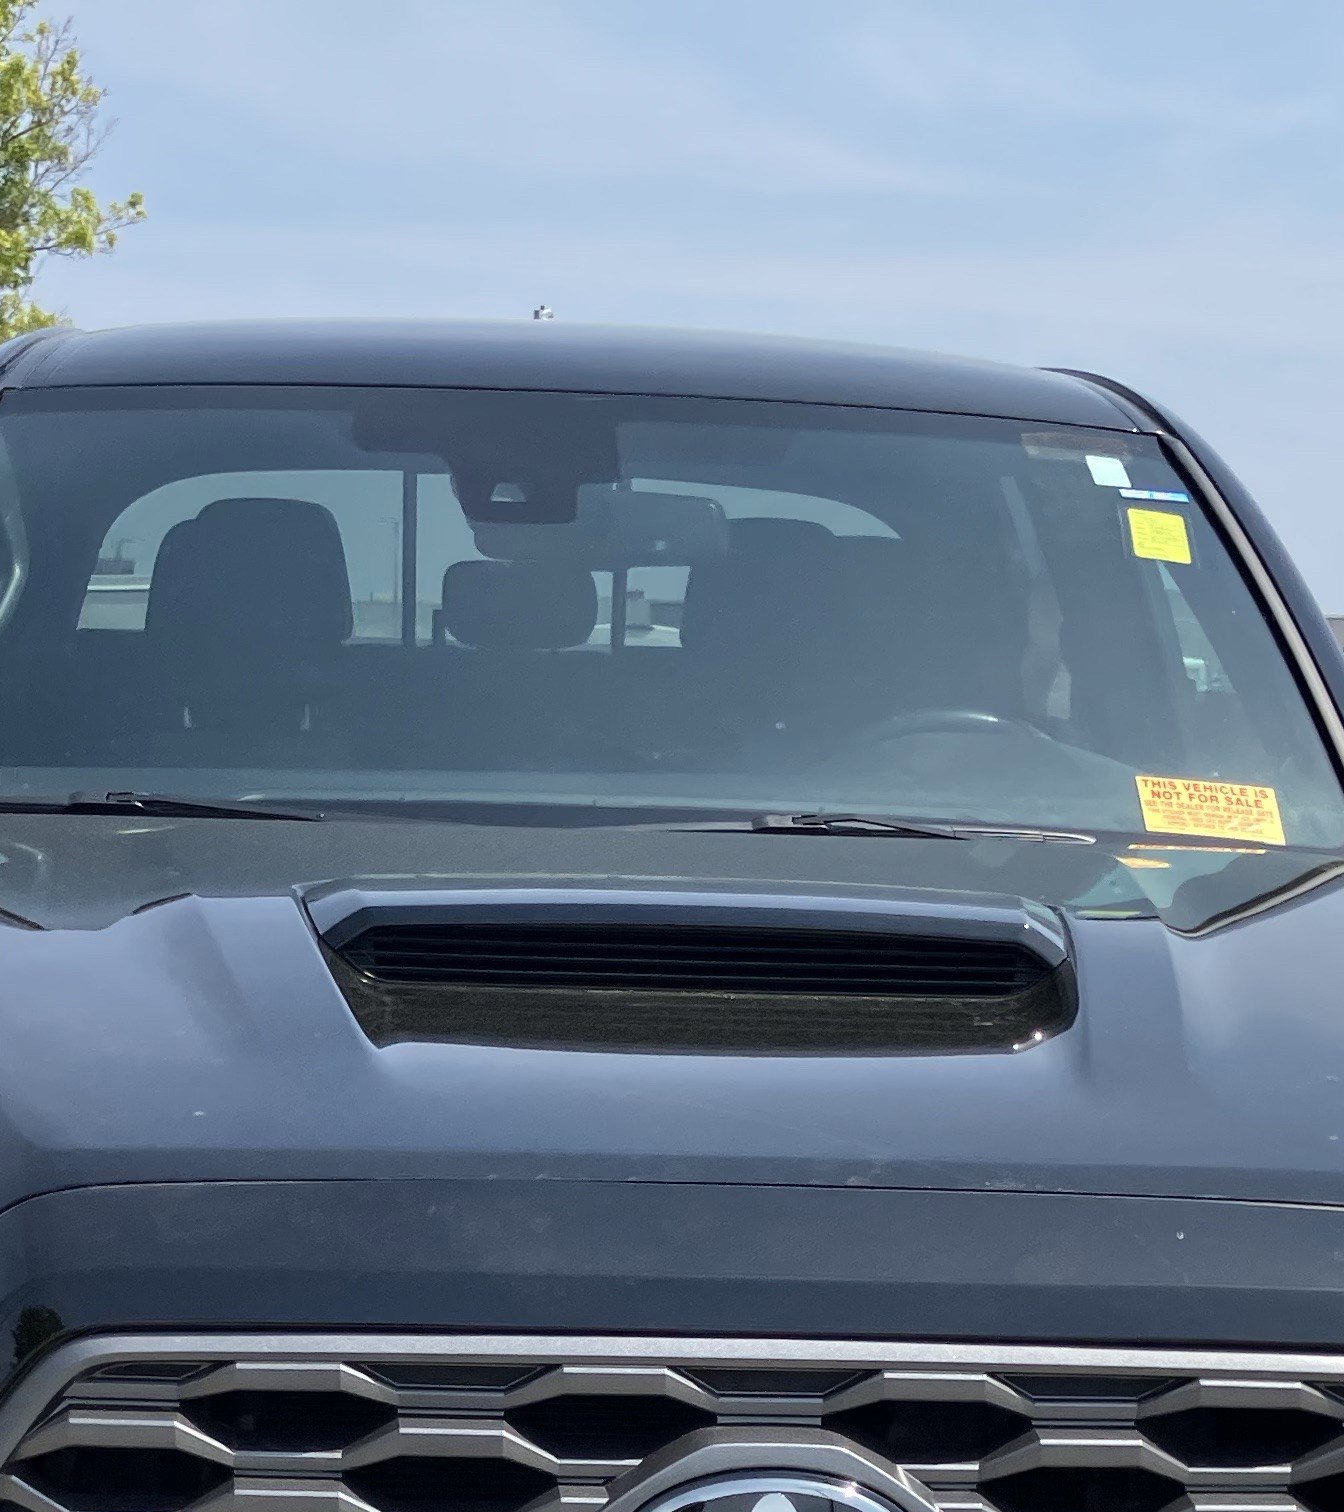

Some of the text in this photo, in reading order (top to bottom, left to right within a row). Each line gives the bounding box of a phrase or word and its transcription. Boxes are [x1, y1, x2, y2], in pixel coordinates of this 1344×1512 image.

[1142, 779, 1269, 799] THIS VEHICLE IS
[1151, 789, 1264, 809] NOT FOR SALE
